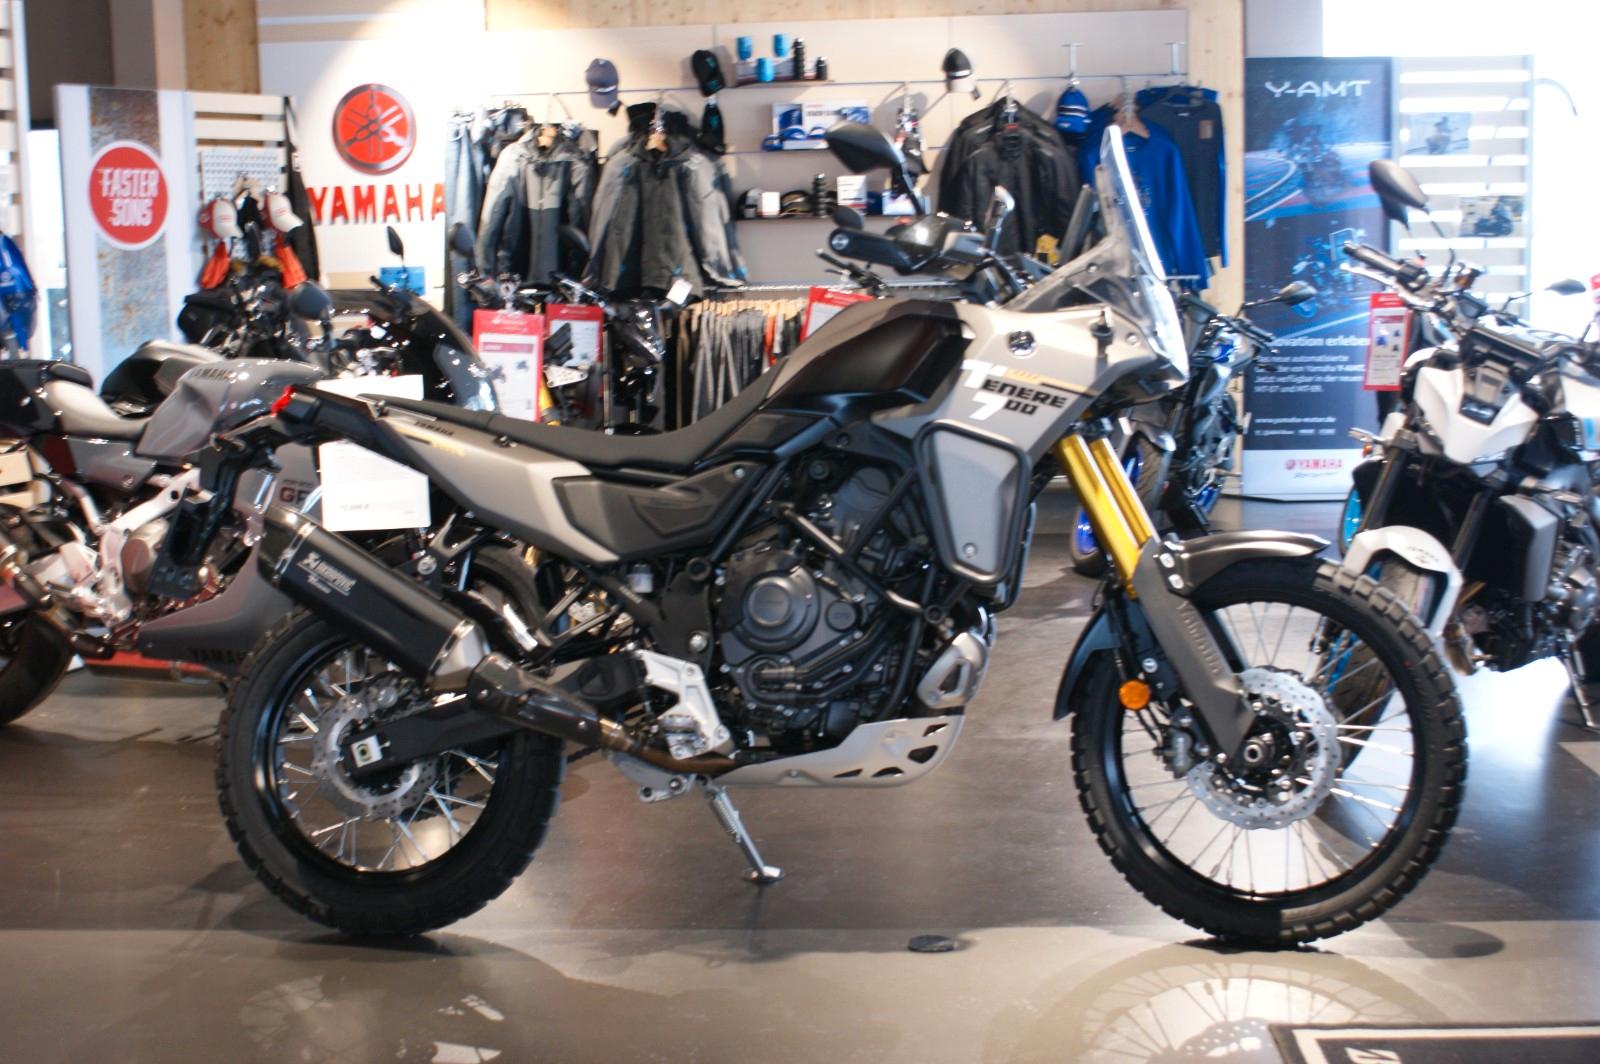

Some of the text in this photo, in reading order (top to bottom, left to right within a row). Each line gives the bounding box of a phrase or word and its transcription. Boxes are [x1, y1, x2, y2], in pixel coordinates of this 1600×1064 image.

[1264, 80, 1371, 98] Y-AMT
[98, 167, 159, 198] FASTER
[109, 198, 154, 227] SONS
[305, 182, 446, 224] YAMAHA
